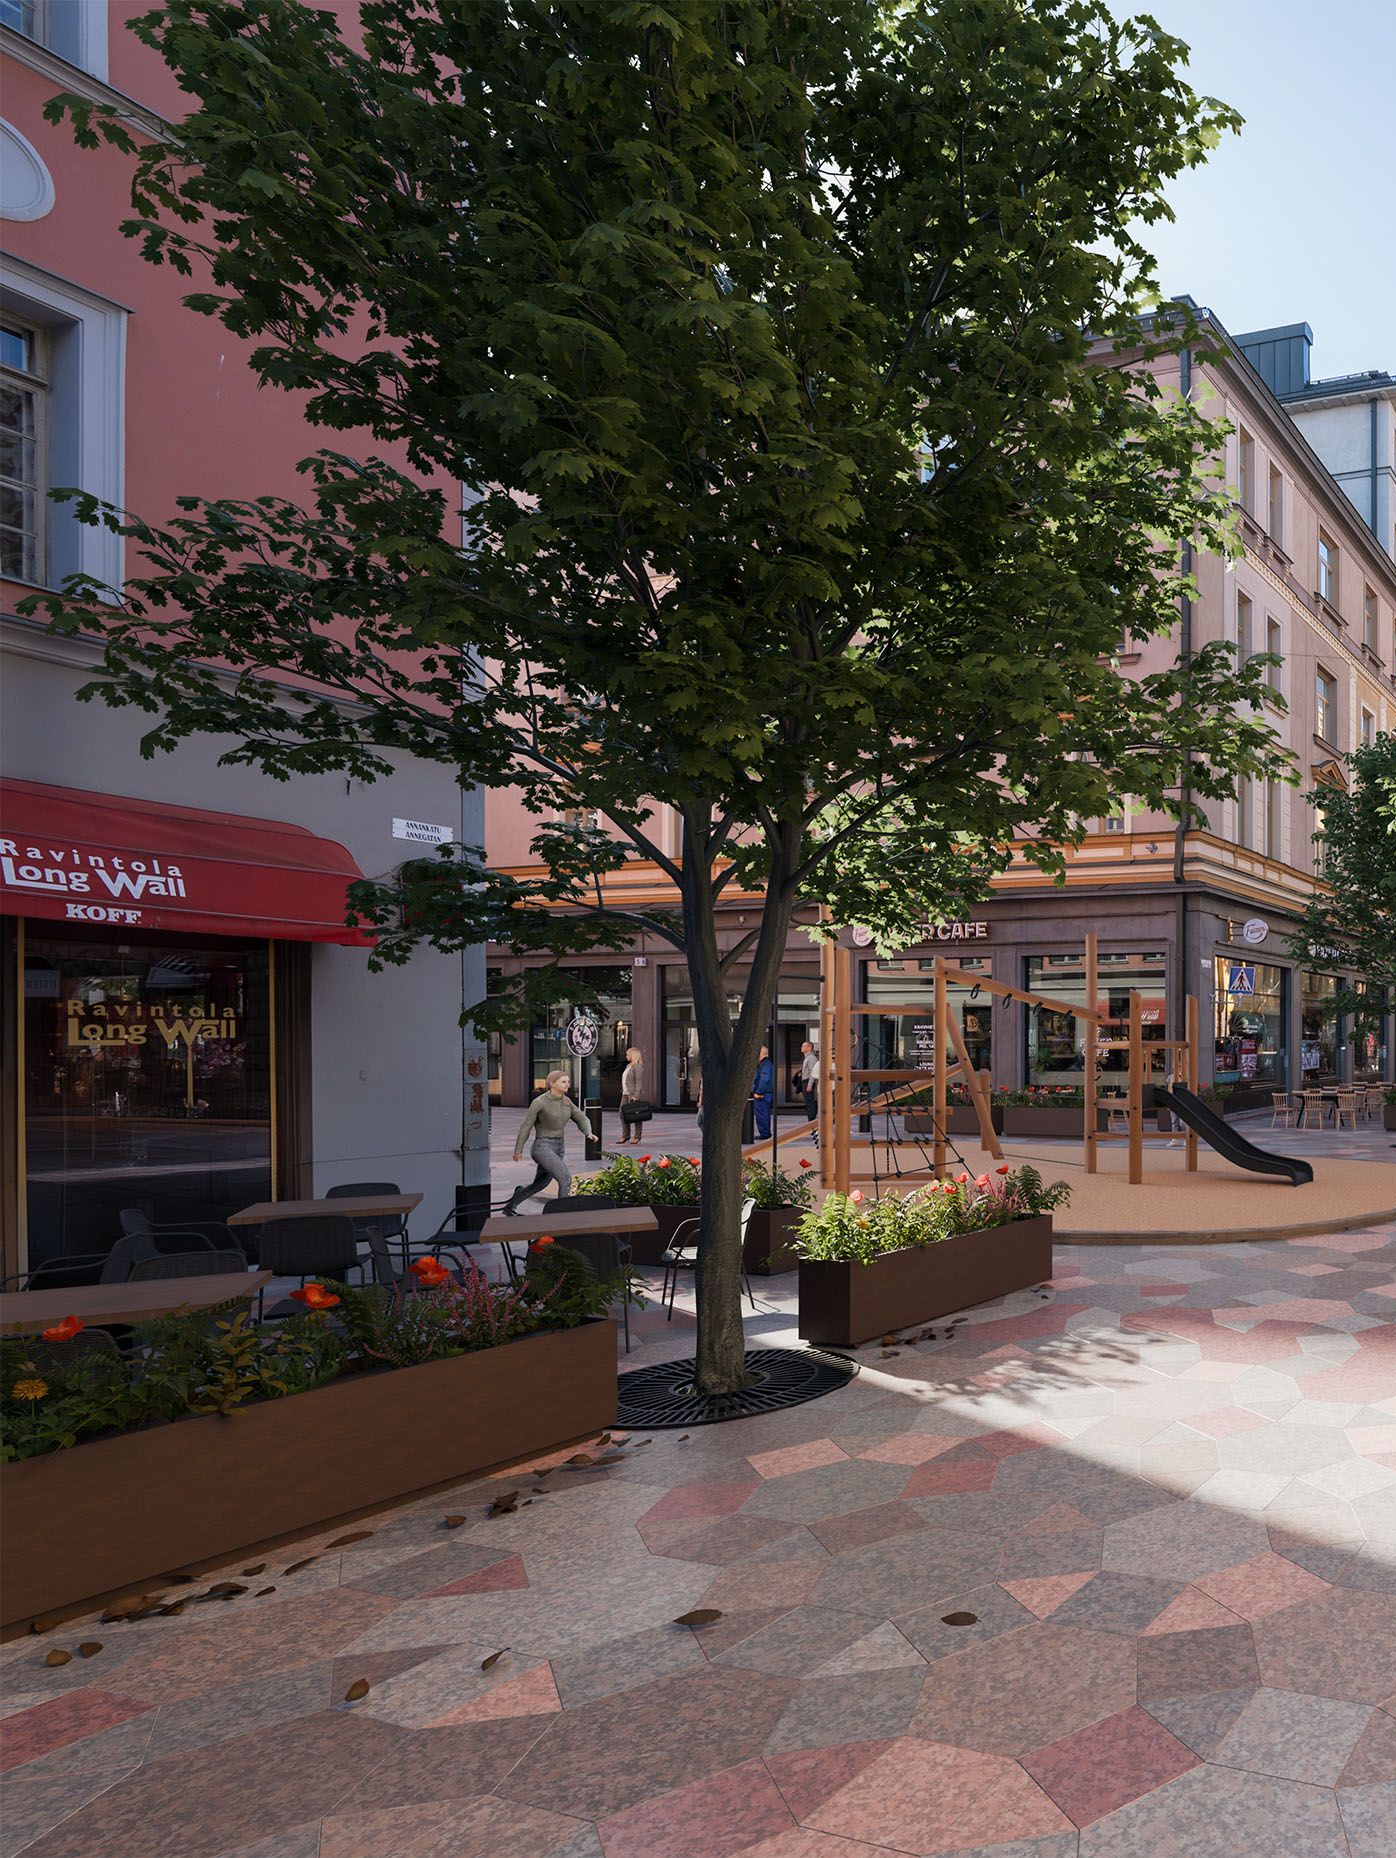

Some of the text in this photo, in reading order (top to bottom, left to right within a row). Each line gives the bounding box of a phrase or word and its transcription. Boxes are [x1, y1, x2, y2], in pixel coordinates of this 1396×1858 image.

[405, 821, 442, 834] ANNANKATU
[405, 831, 442, 843] ANNEGATAN
[0, 838, 183, 877] Ravintola
[1, 856, 187, 900] Long Wall
[65, 903, 142, 924] KOFF
[67, 1000, 236, 1018] Ravintola
[67, 1017, 236, 1048] Long Wall
